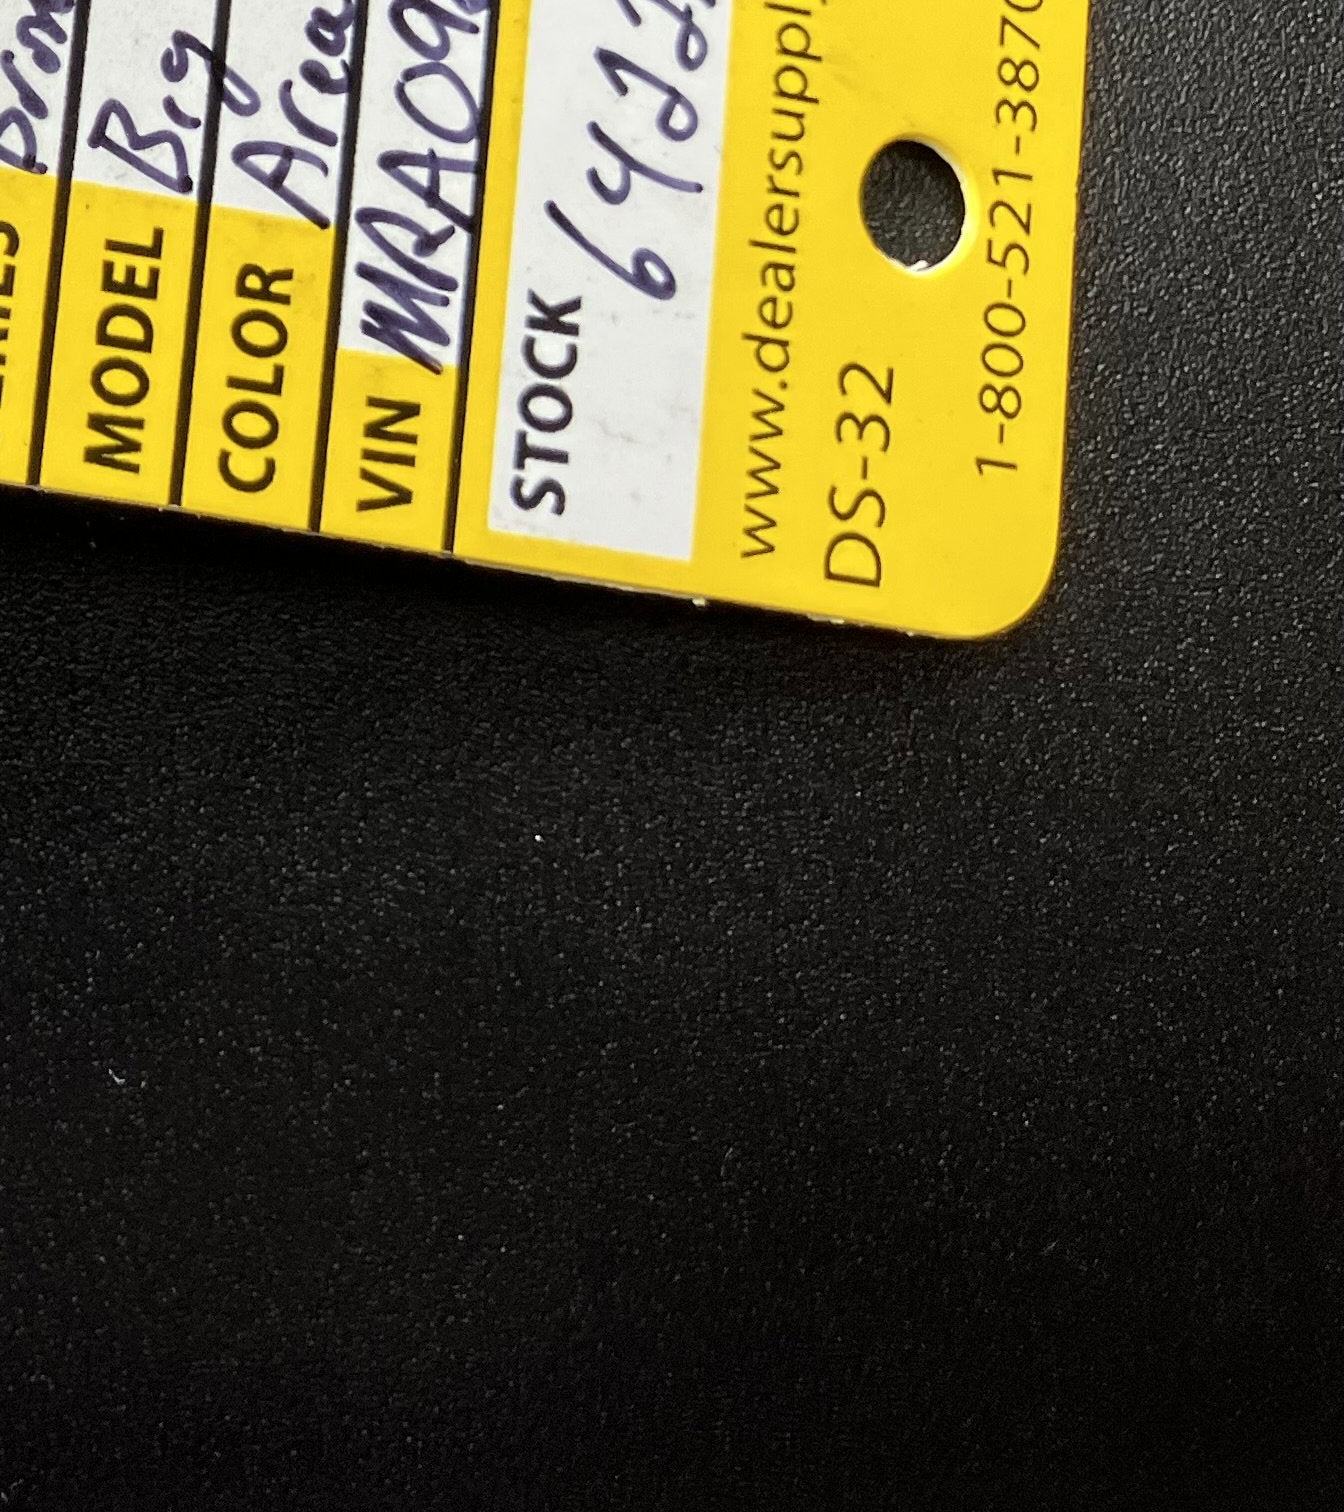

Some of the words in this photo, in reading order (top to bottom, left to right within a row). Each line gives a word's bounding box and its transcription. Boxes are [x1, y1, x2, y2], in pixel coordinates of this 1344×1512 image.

[88, 28, 262, 194] Big
[85, 226, 165, 474] MODEL
[218, 260, 296, 492] COLOR
[357, 394, 422, 514] VIN
[510, 291, 584, 516] STOCK
[822, 362, 896, 588] DS-32
